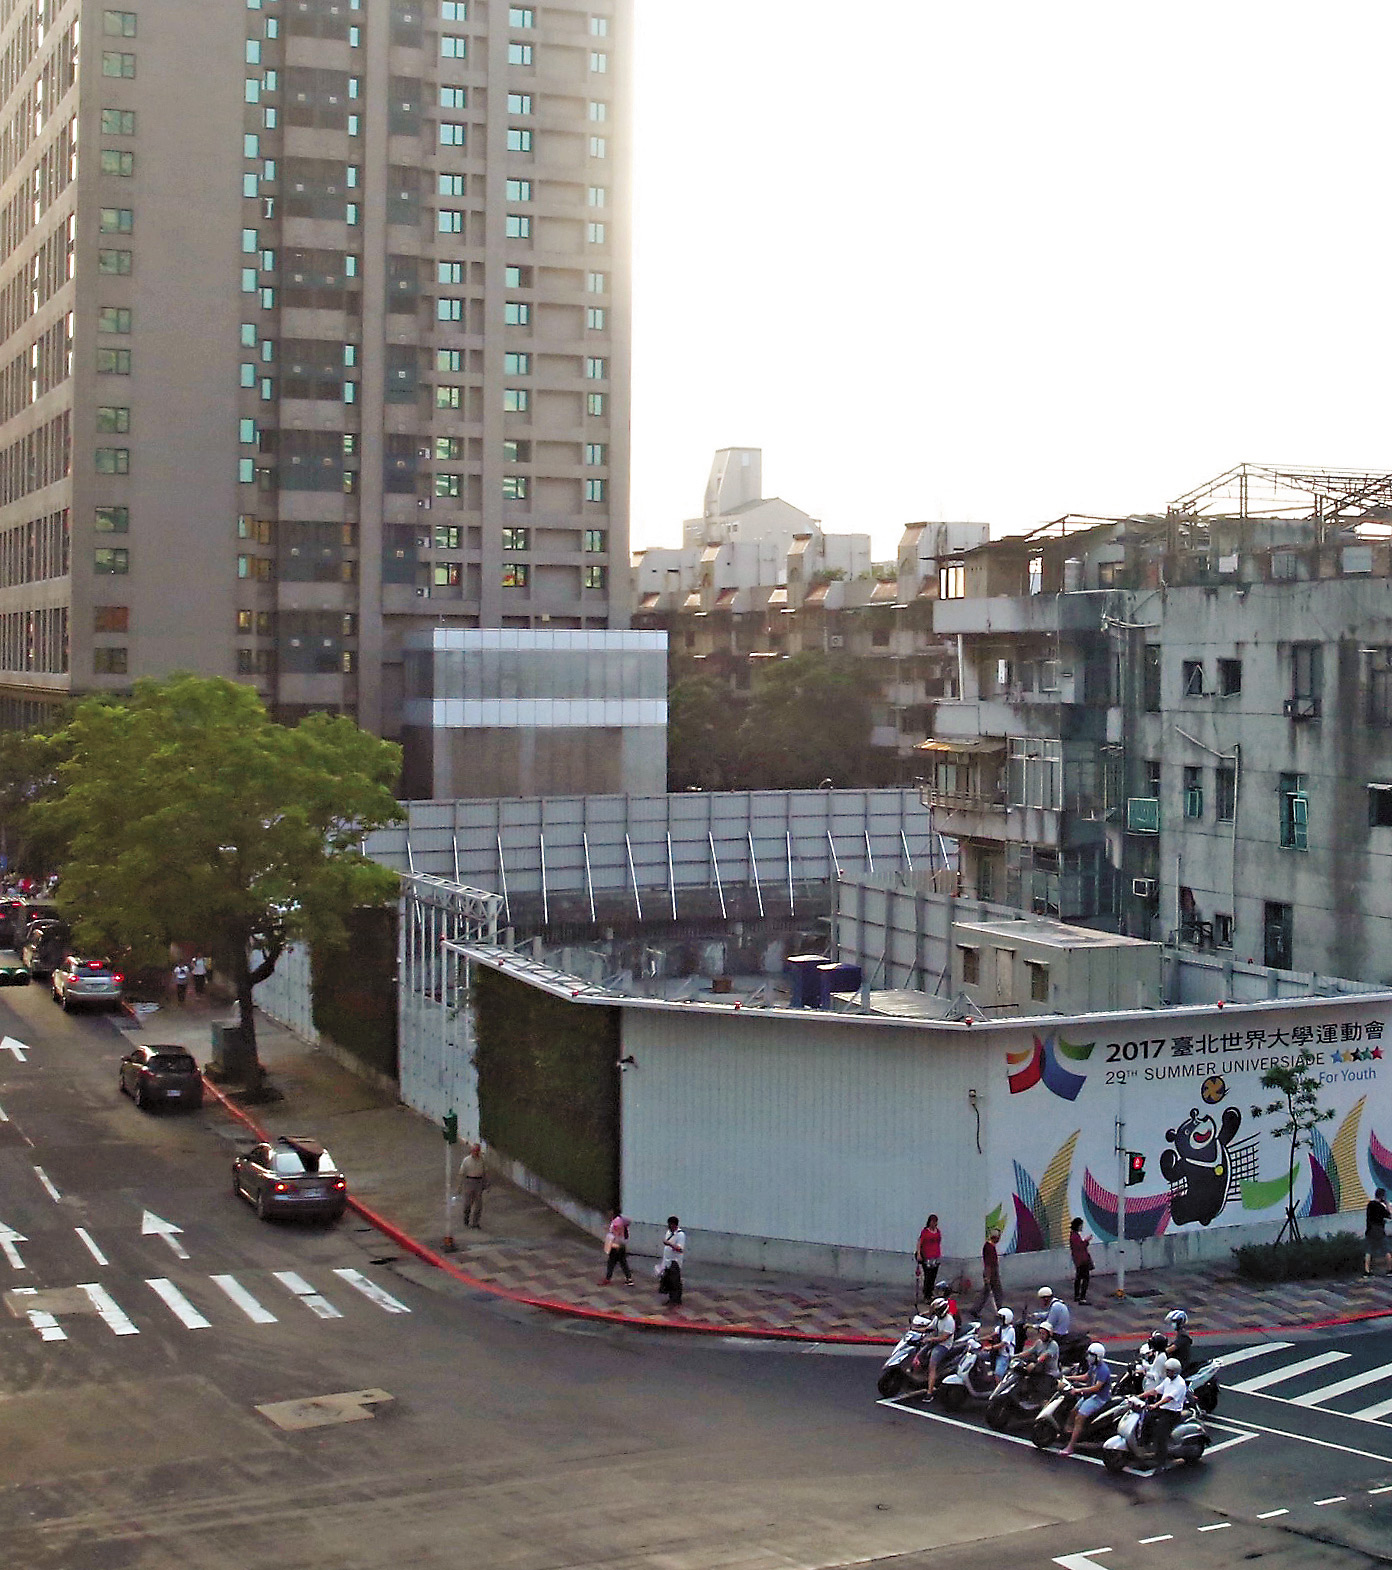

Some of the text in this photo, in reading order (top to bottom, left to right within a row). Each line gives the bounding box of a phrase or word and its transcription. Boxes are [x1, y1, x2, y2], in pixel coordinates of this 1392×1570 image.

[1144, 1062, 1217, 1081] SUMMER
[1222, 1052, 1325, 1075] UNIVERSIADE
[1319, 1071, 1338, 1083] For
[1341, 1067, 1377, 1082] Youth
